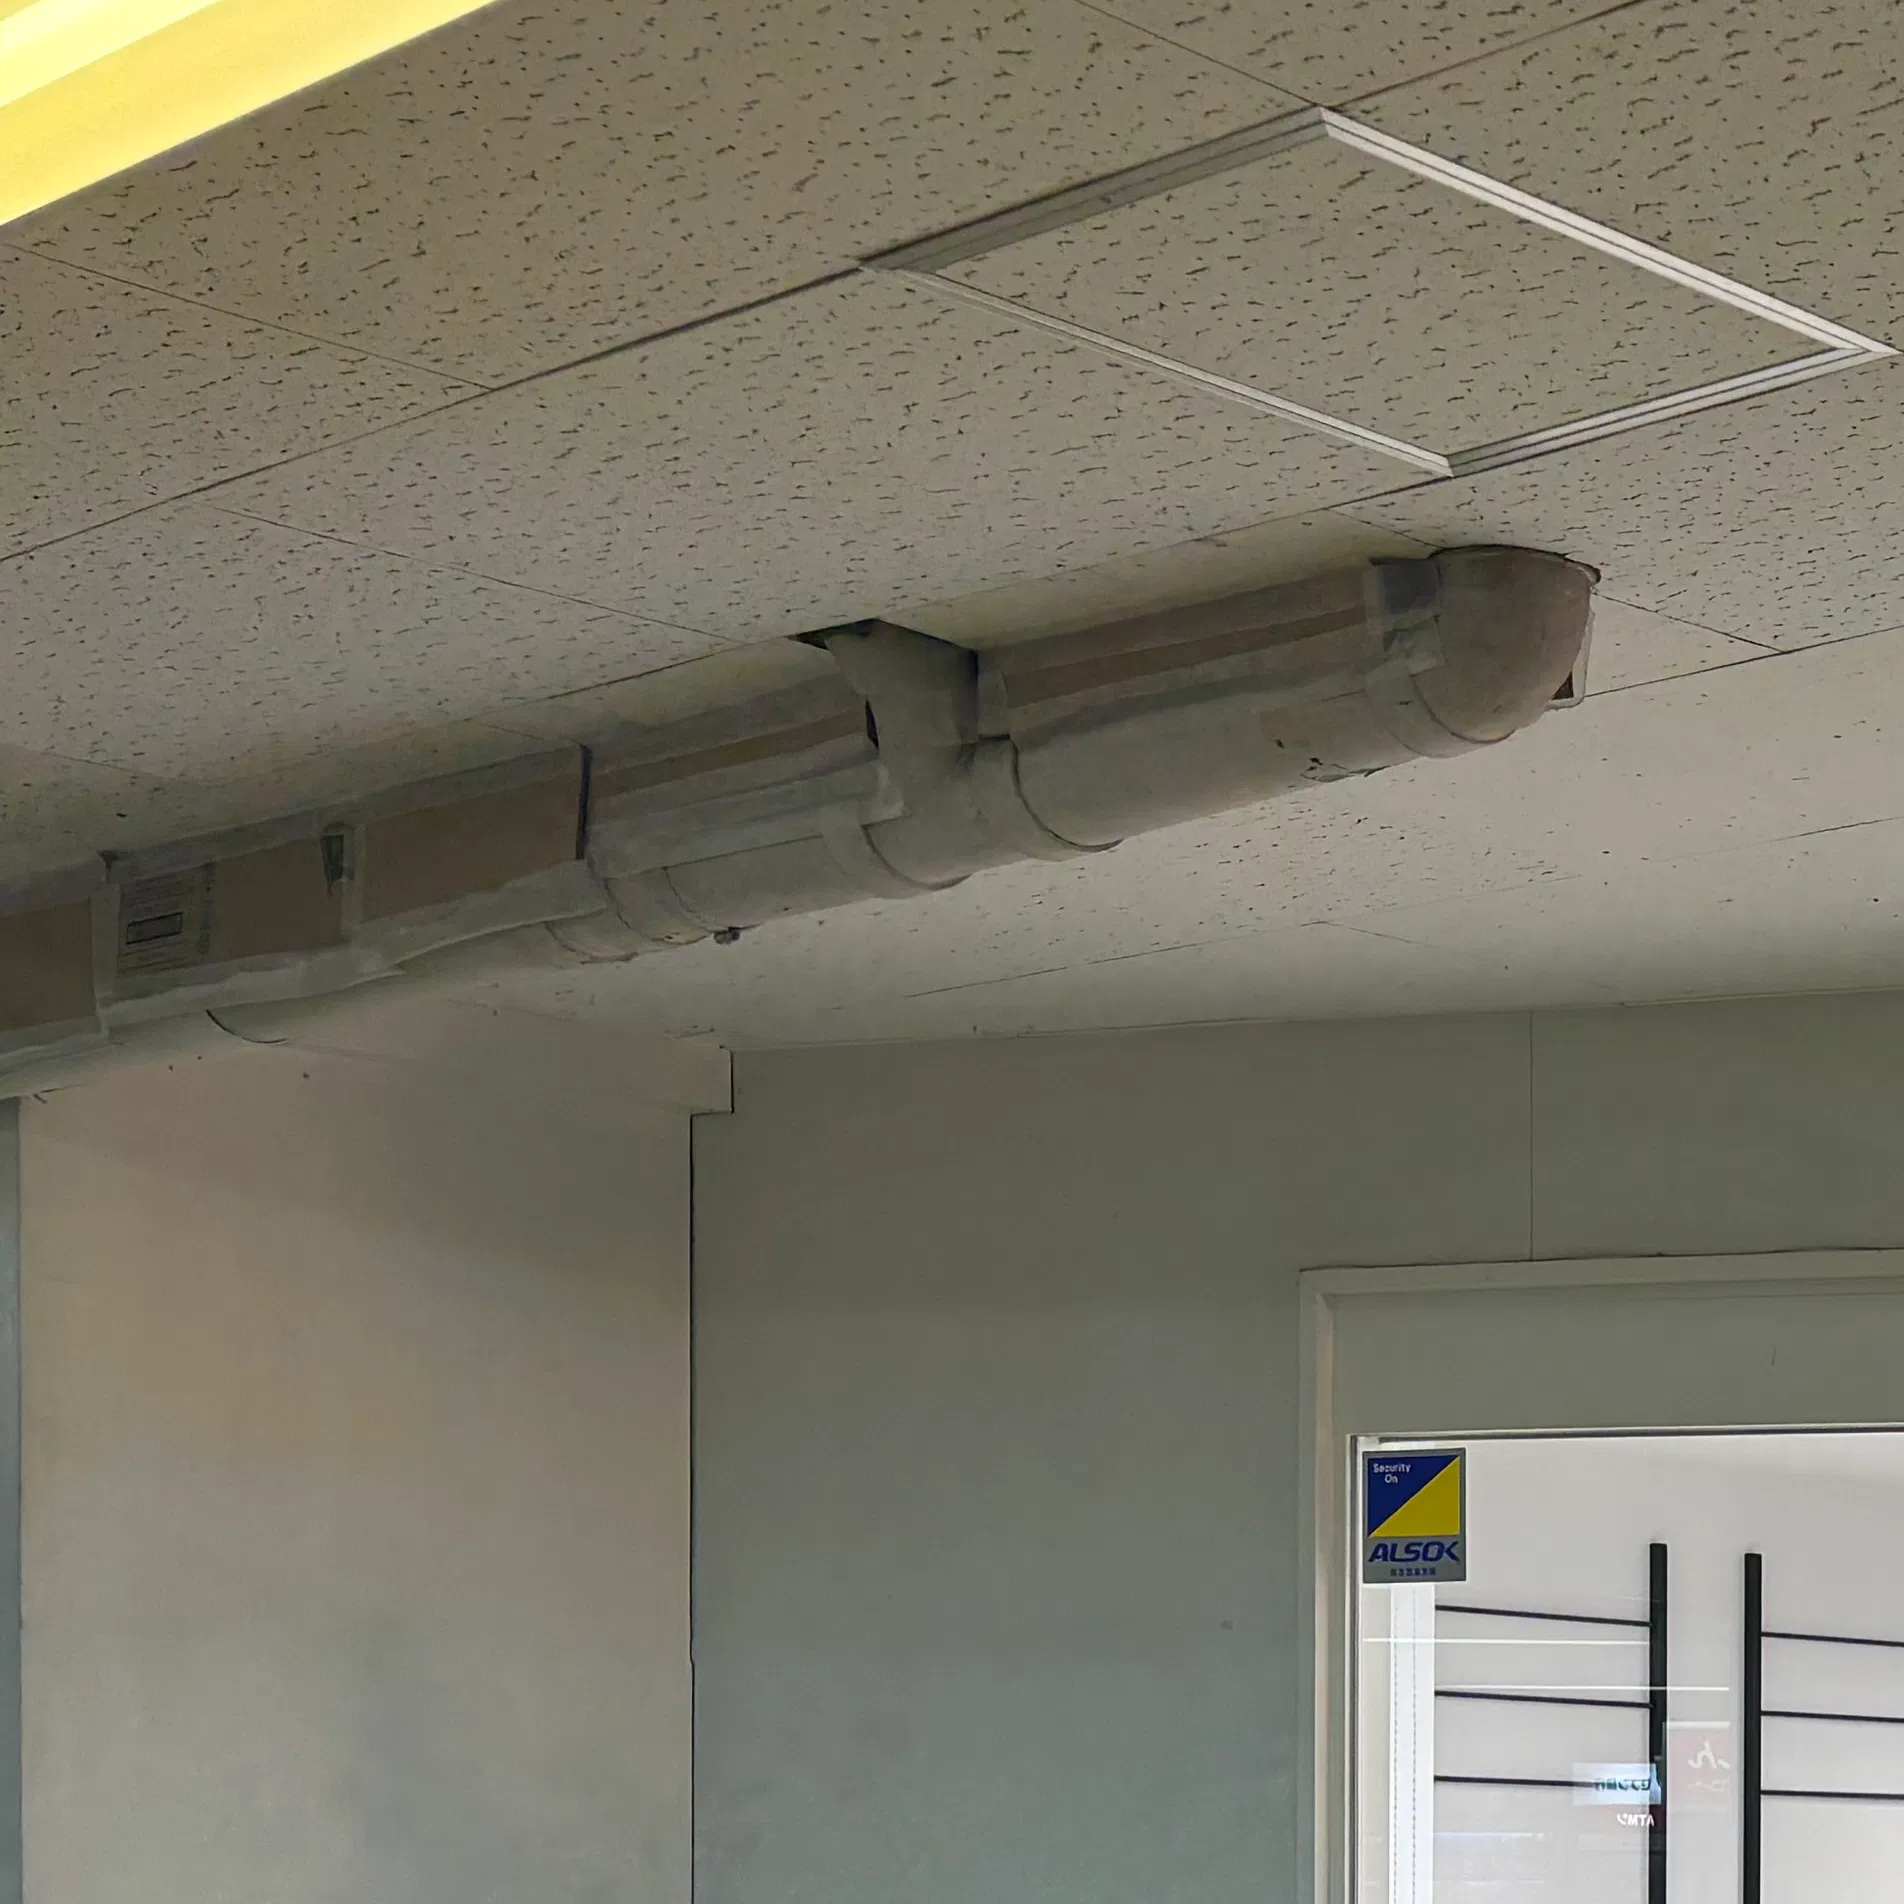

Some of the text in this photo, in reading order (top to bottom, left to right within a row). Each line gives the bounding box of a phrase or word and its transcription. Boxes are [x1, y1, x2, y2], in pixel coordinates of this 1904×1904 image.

[1373, 1464, 1411, 1473] Security
[1384, 1474, 1398, 1483] On
[1368, 1541, 1460, 1563] ALSOK
